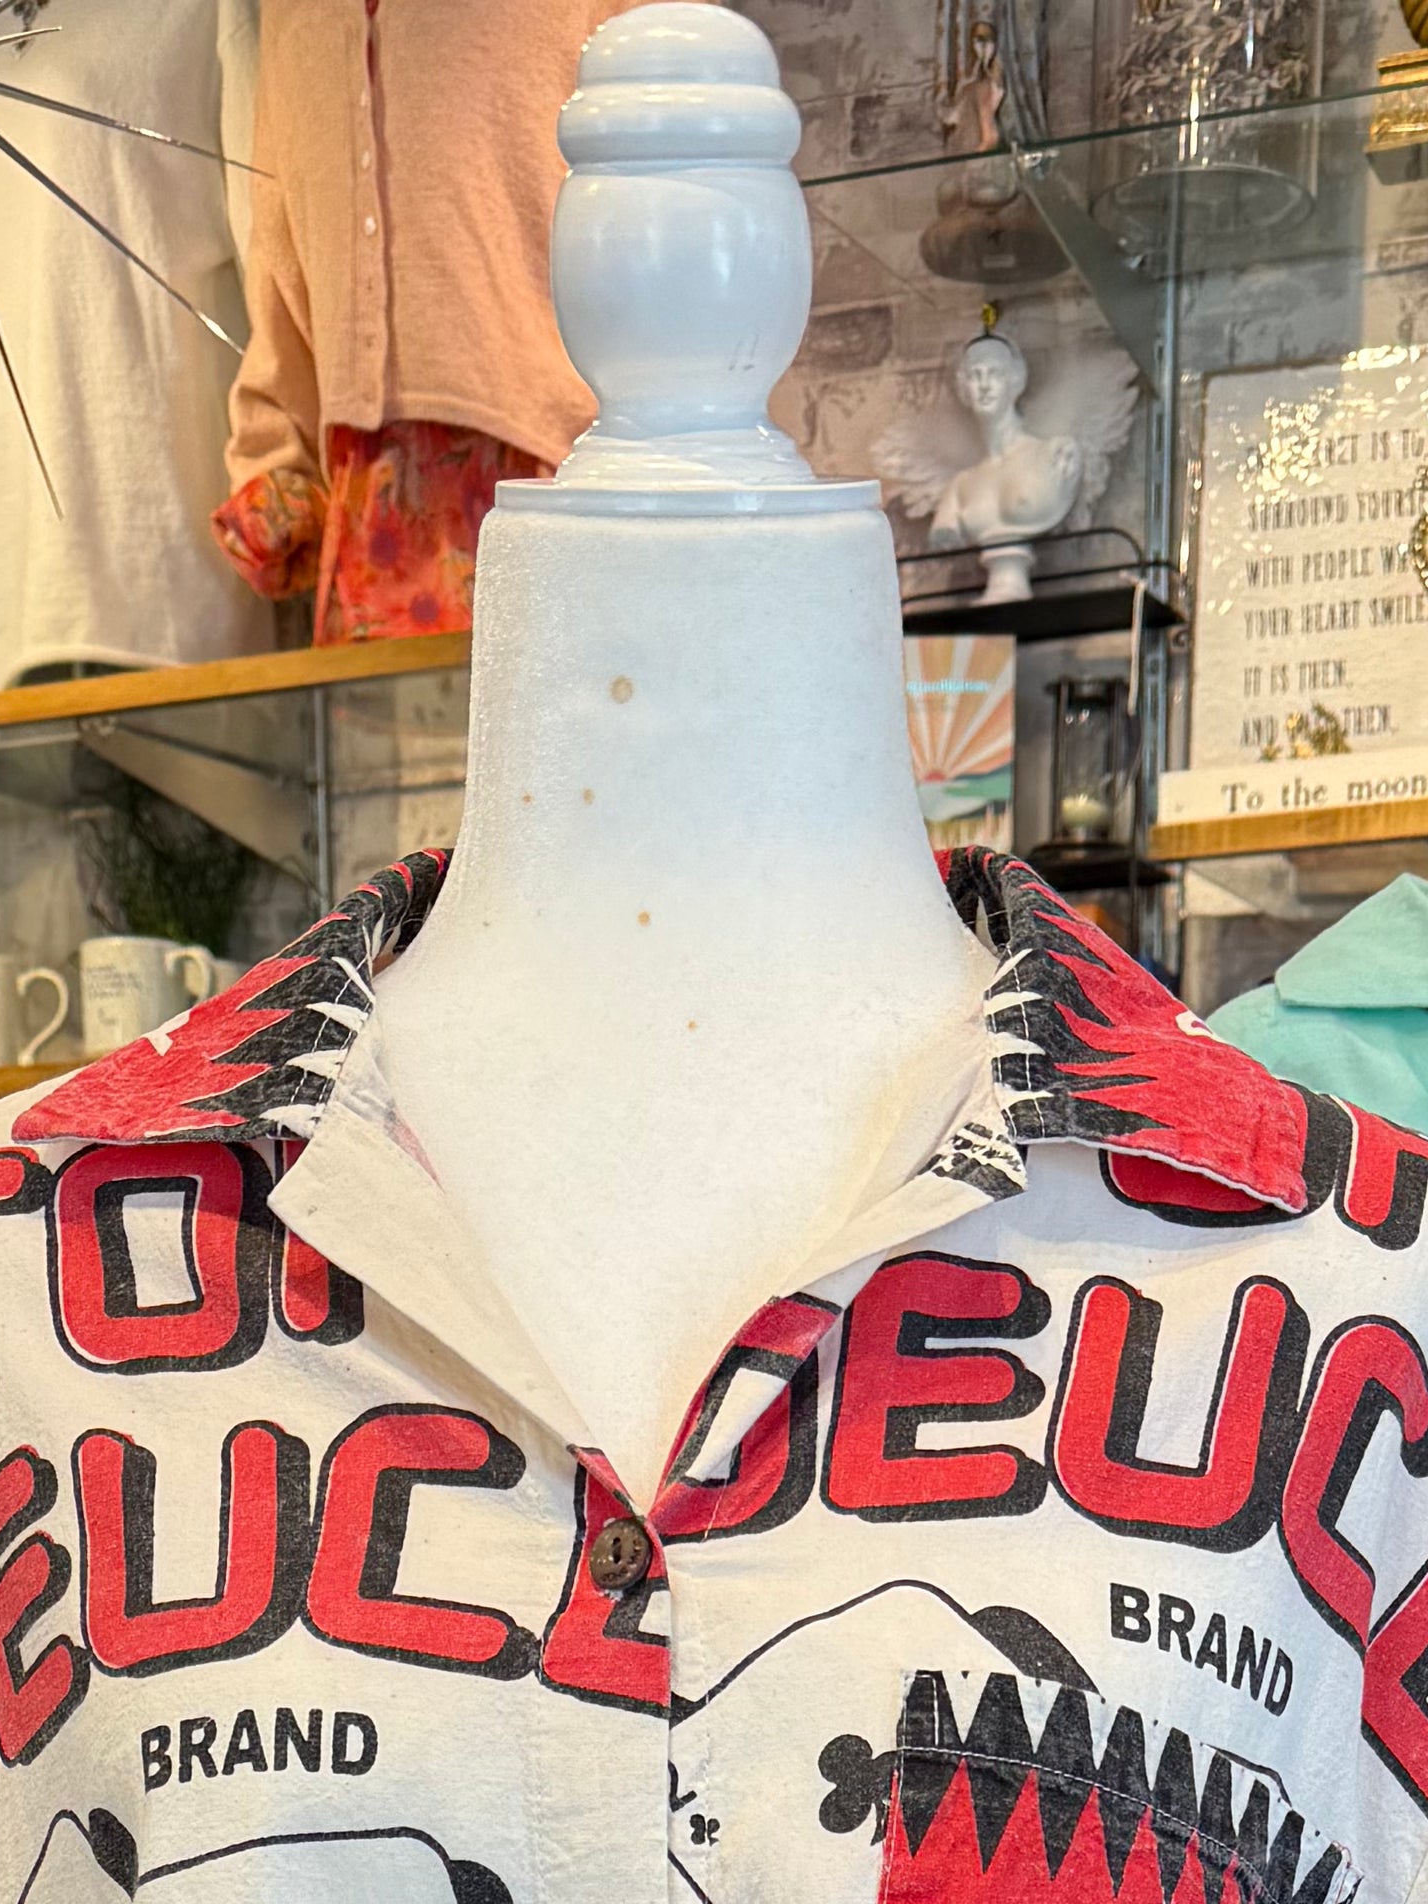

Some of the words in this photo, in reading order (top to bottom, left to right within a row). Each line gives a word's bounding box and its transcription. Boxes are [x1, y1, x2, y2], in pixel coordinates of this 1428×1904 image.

[1245, 606, 1293, 640] YOUR
[1300, 599, 1361, 634] HEART
[1222, 782, 1264, 814] To
[1281, 777, 1328, 808] the
[1347, 774, 1428, 802] moon
[1108, 1582, 1295, 1716] BRAND
[141, 1707, 380, 1791] BRAND
